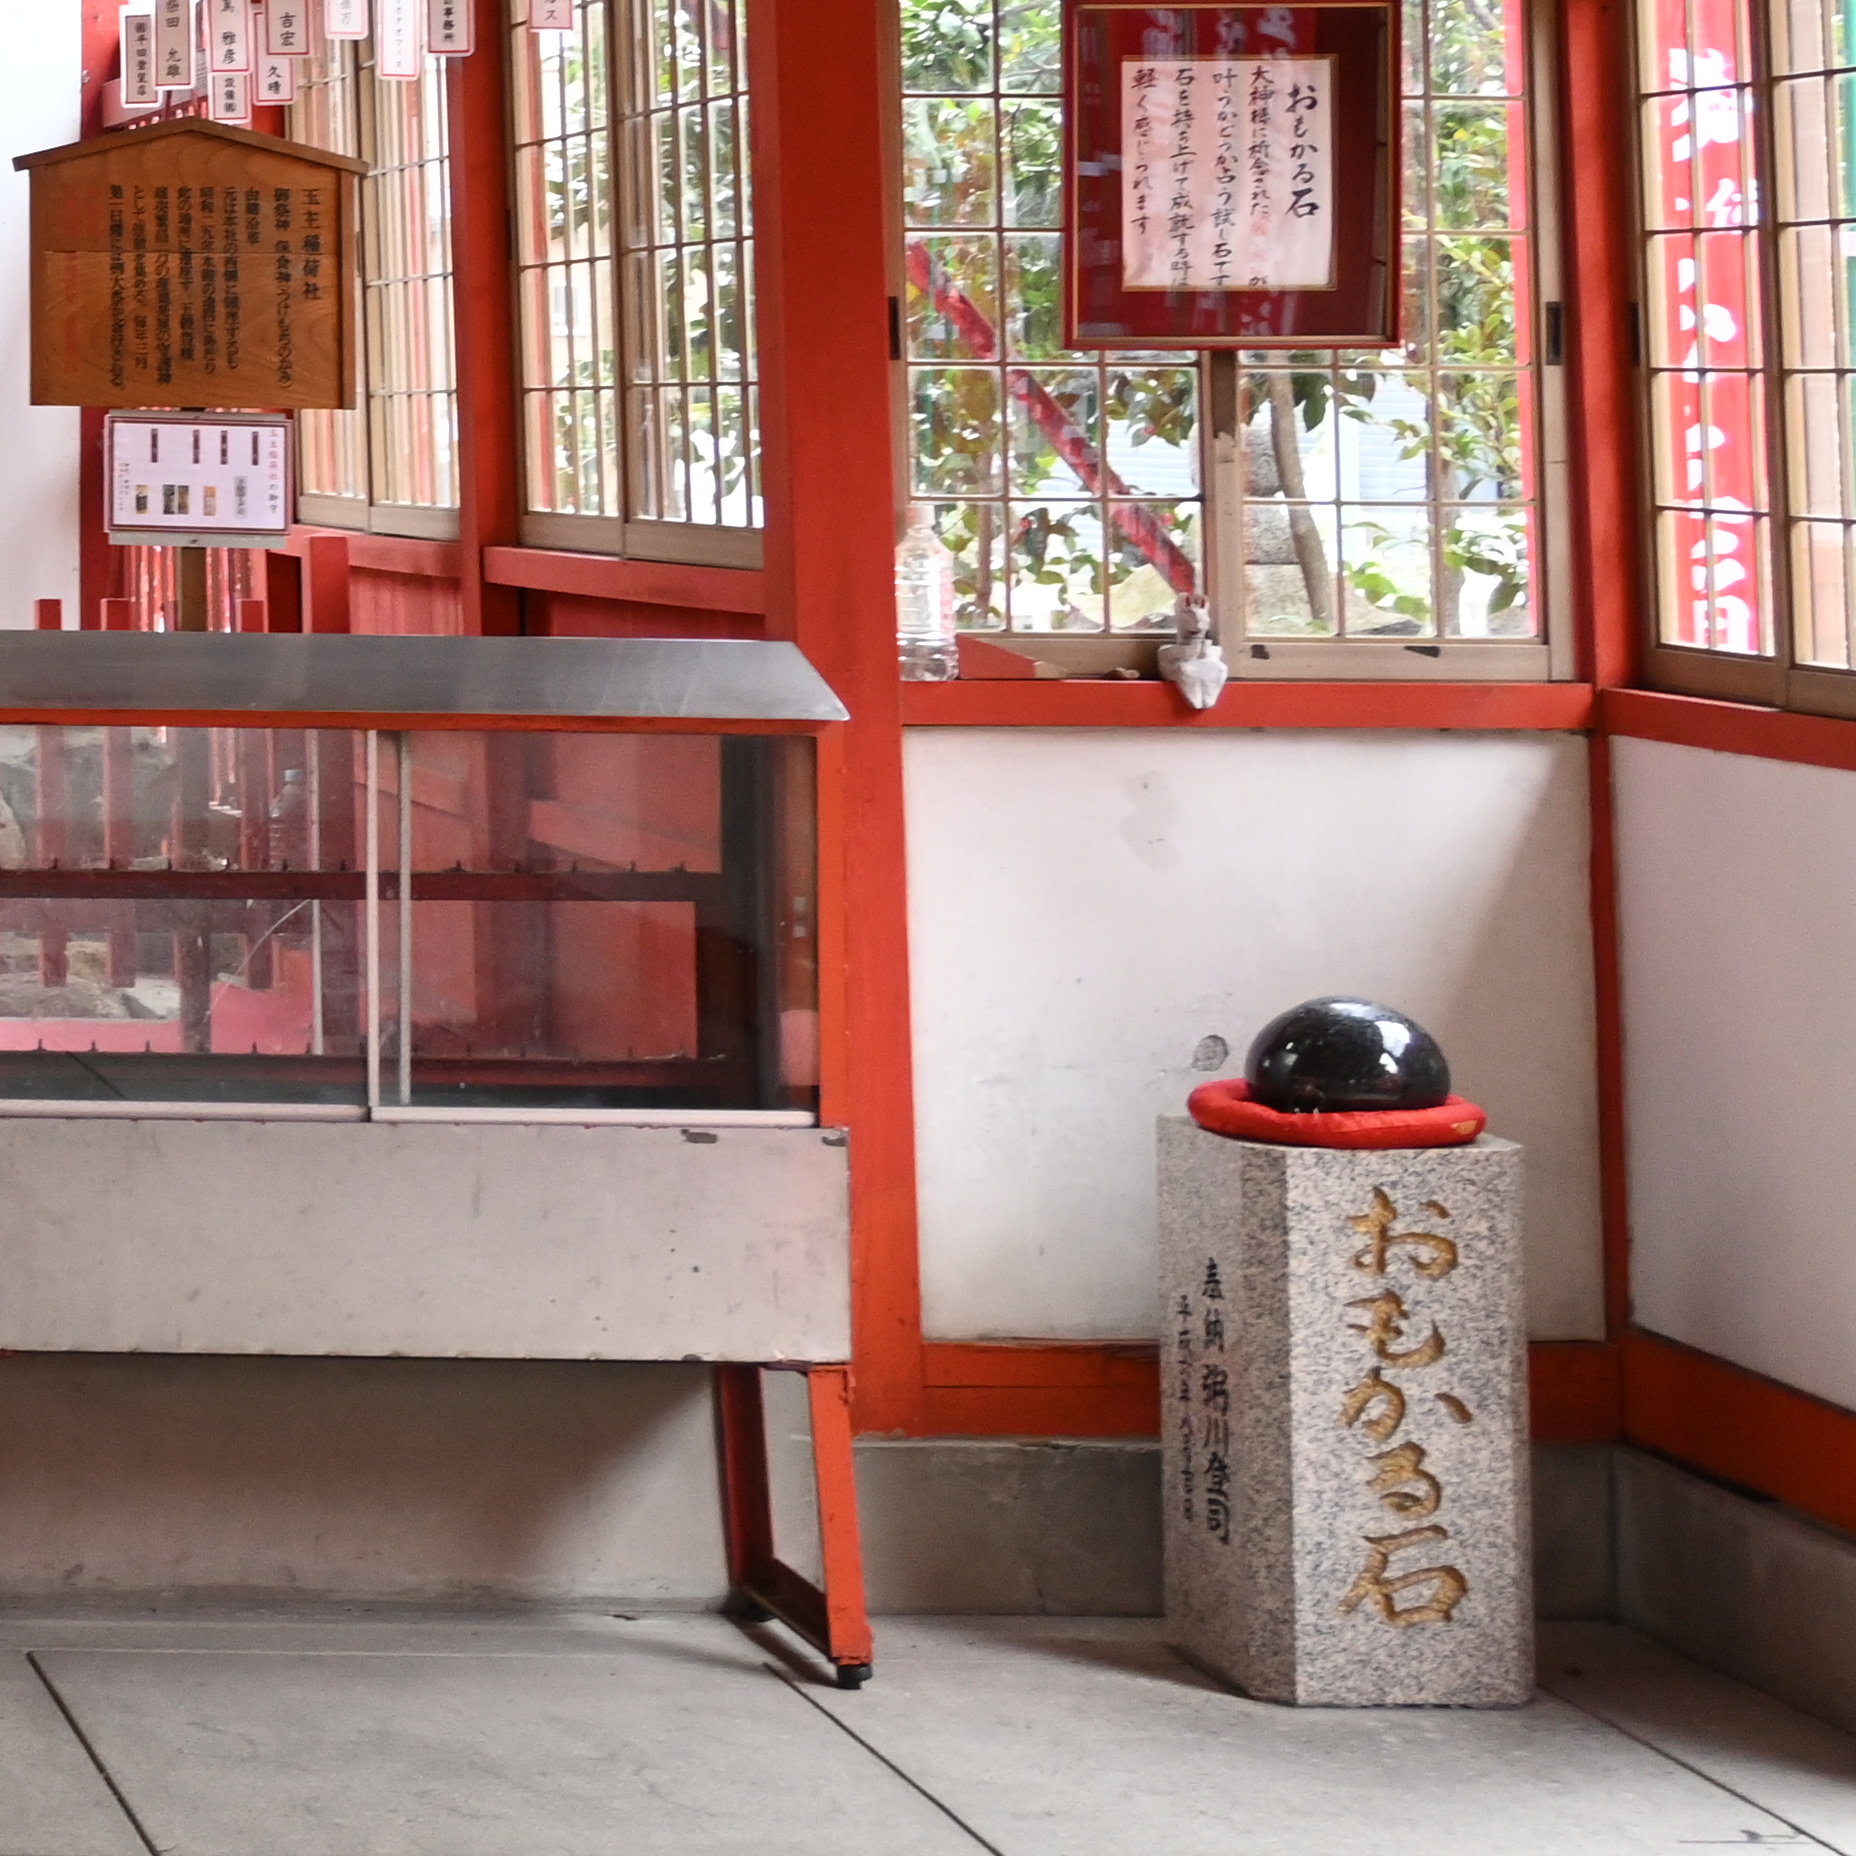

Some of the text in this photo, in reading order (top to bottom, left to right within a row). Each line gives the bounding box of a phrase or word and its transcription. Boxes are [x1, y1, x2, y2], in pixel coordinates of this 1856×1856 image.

[1286, 83, 1320, 218] おもかる石
[1338, 1185, 1473, 1626] おもかる石
